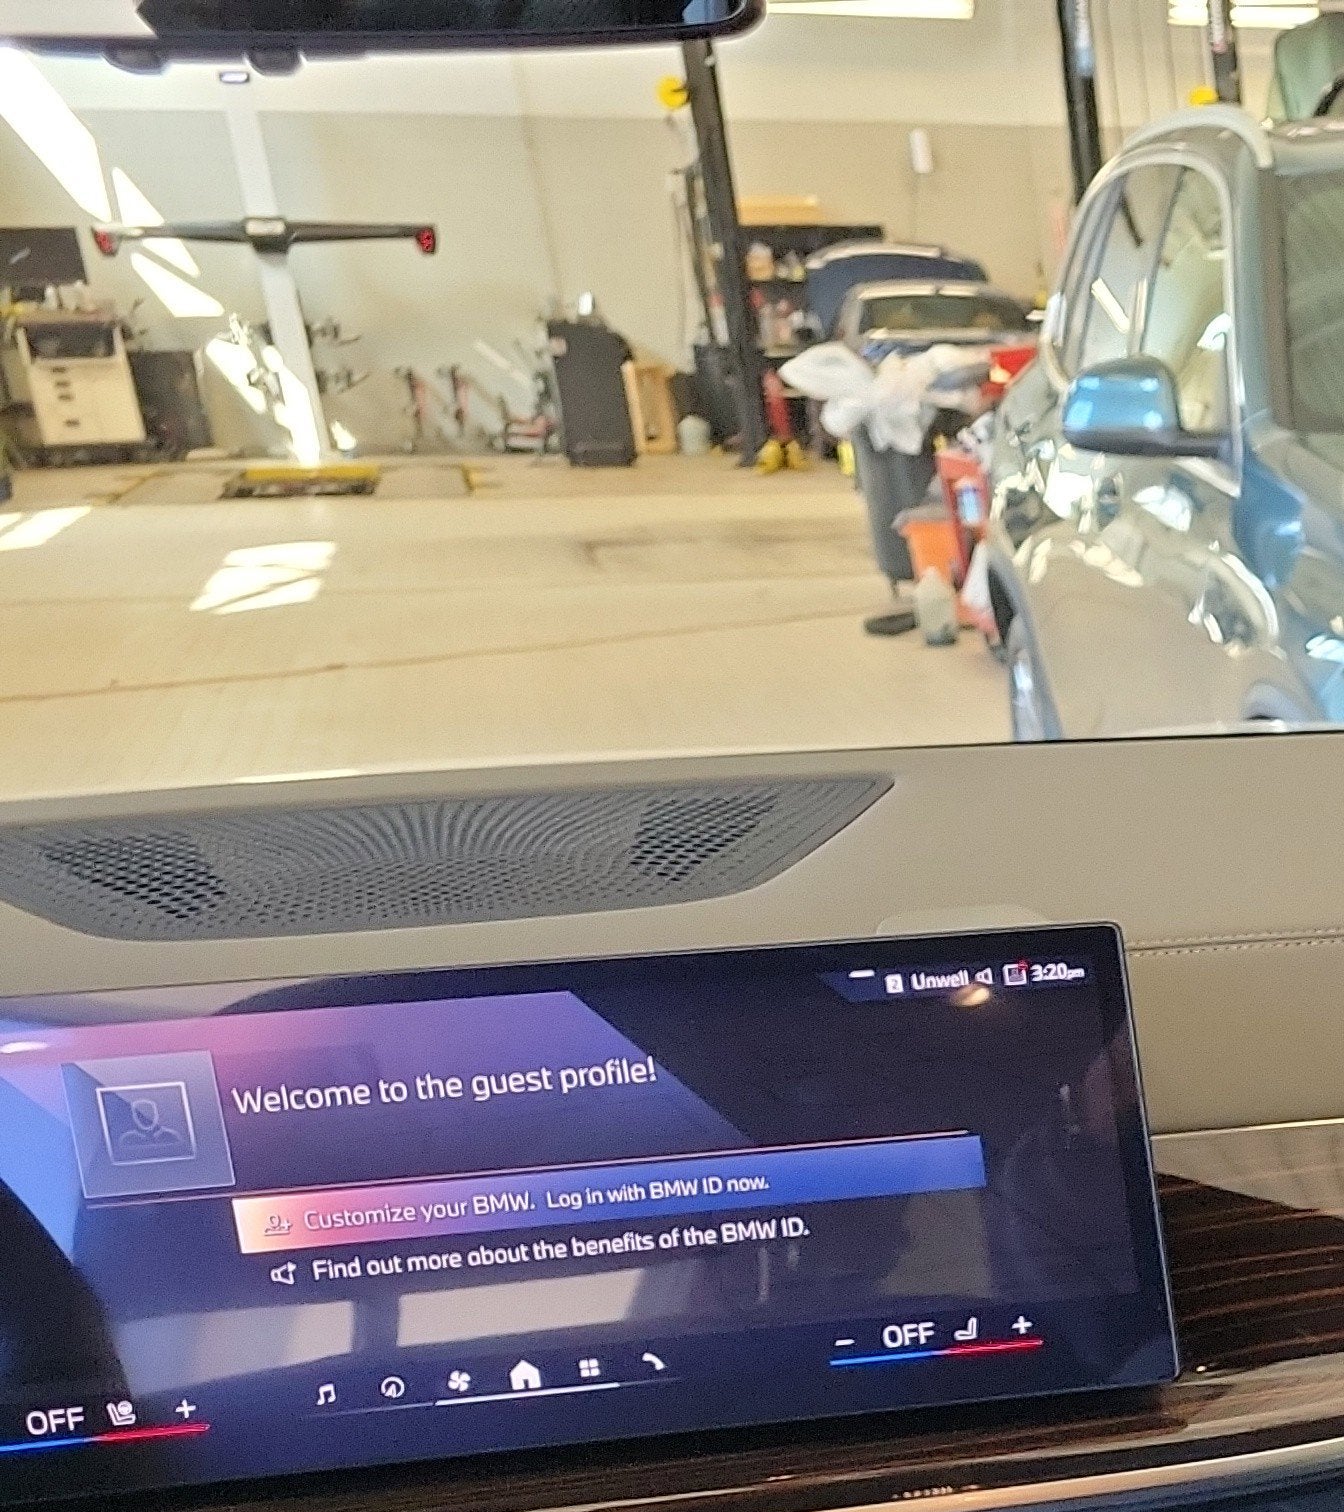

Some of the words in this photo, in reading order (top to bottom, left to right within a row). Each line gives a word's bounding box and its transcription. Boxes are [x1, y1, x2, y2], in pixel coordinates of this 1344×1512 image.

[910, 969, 970, 991] Unwell
[231, 1081, 371, 1115] Welcome
[379, 1079, 409, 1104] to
[415, 1072, 463, 1100] the
[472, 1066, 553, 1102] guest
[559, 1055, 657, 1094] profile!
[304, 1202, 416, 1231] Customize
[420, 1201, 469, 1230] your
[474, 1191, 536, 1217] BMW.
[546, 1189, 583, 1211] Log
[586, 1187, 603, 1205] in
[606, 1183, 646, 1203] with
[649, 1178, 698, 1200] BMW
[702, 1176, 723, 1196] ID
[726, 1176, 771, 1193] now.
[312, 1257, 362, 1282] Find
[366, 1253, 402, 1278] out
[406, 1249, 463, 1273] more
[467, 1242, 528, 1268] about
[532, 1239, 567, 1261] the
[571, 1230, 655, 1258] benefits
[658, 1228, 682, 1249] of
[683, 1226, 718, 1247] the
[720, 1219, 777, 1244] BMW
[781, 1216, 811, 1239] ID.
[882, 1321, 935, 1349] OFF
[26, 1406, 85, 1436] OFF
